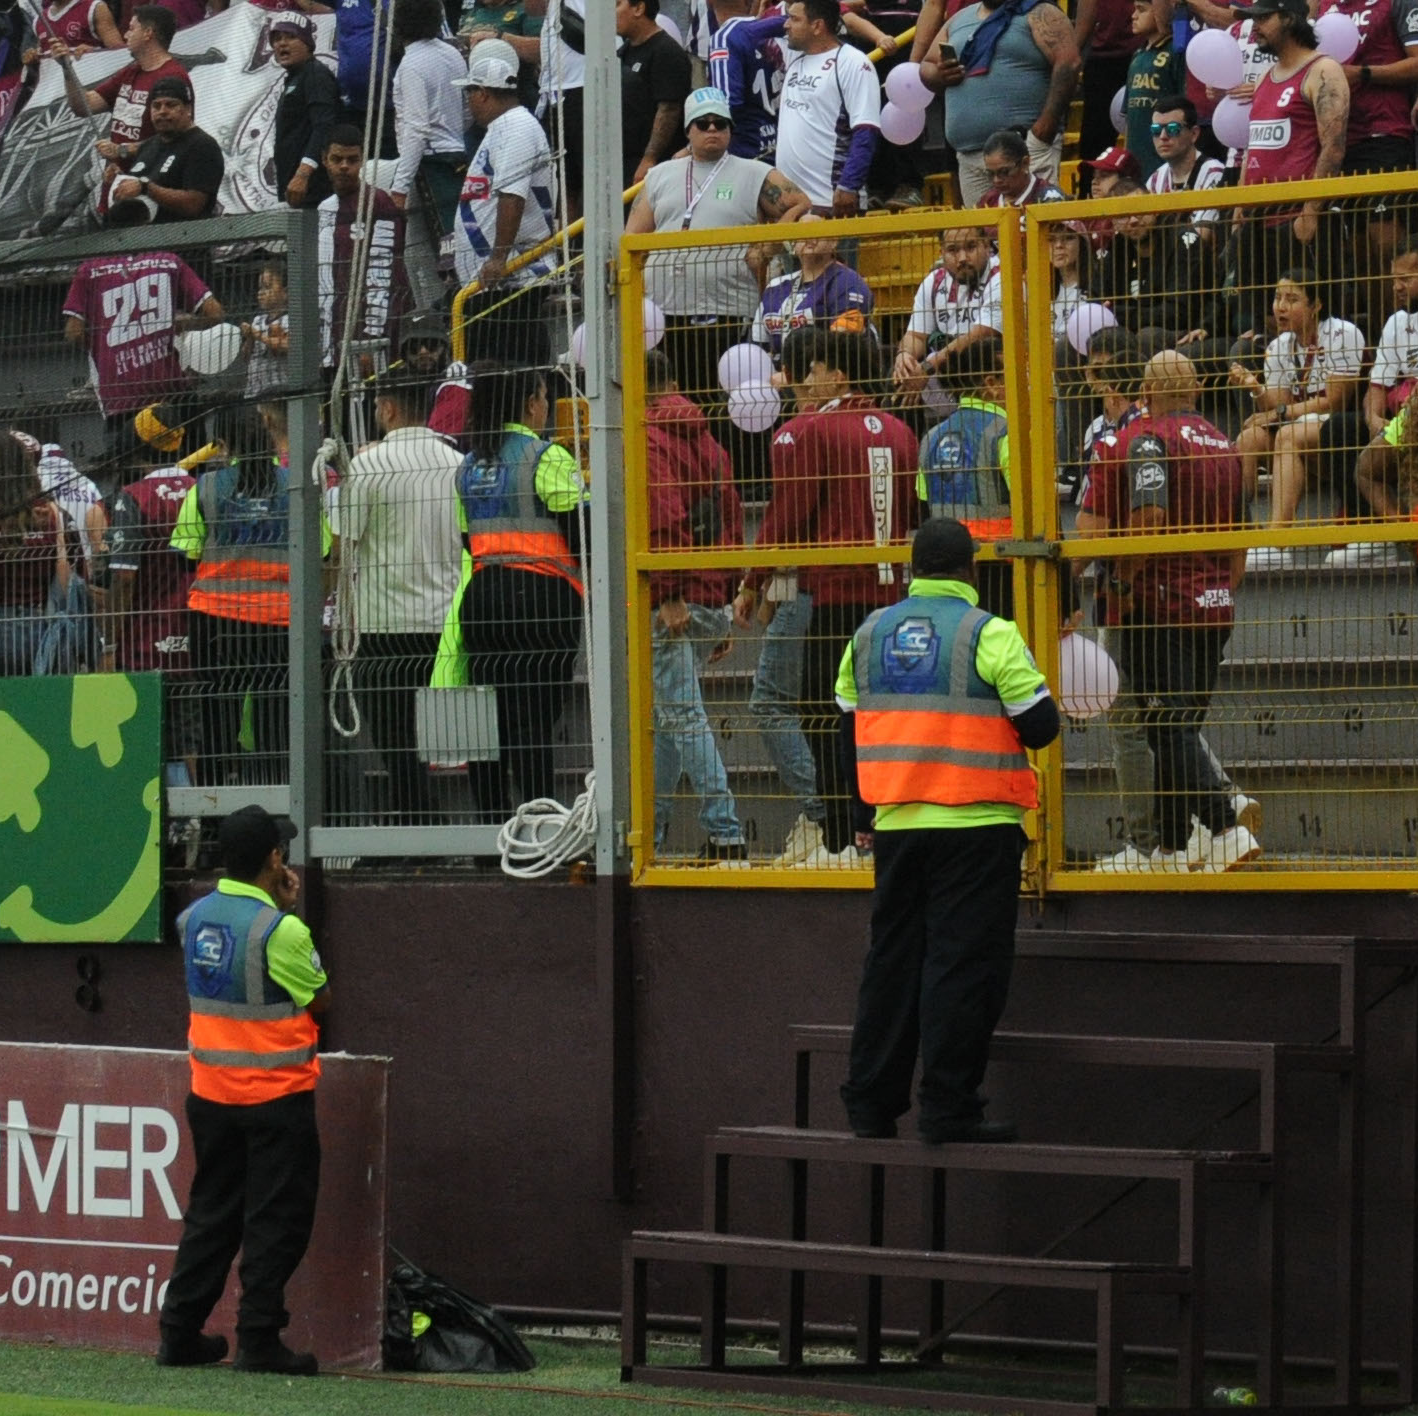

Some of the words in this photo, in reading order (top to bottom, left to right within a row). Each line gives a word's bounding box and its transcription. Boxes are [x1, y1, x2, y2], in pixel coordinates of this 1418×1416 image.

[822, 59, 836, 70] S
[1153, 51, 1169, 66] S
[1133, 74, 1160, 90] BAC
[1128, 97, 1158, 108] ERTY
[1277, 88, 1294, 108] S
[101, 273, 174, 347] 29
[1294, 614, 1307, 636] 11
[1388, 614, 1408, 635] 12
